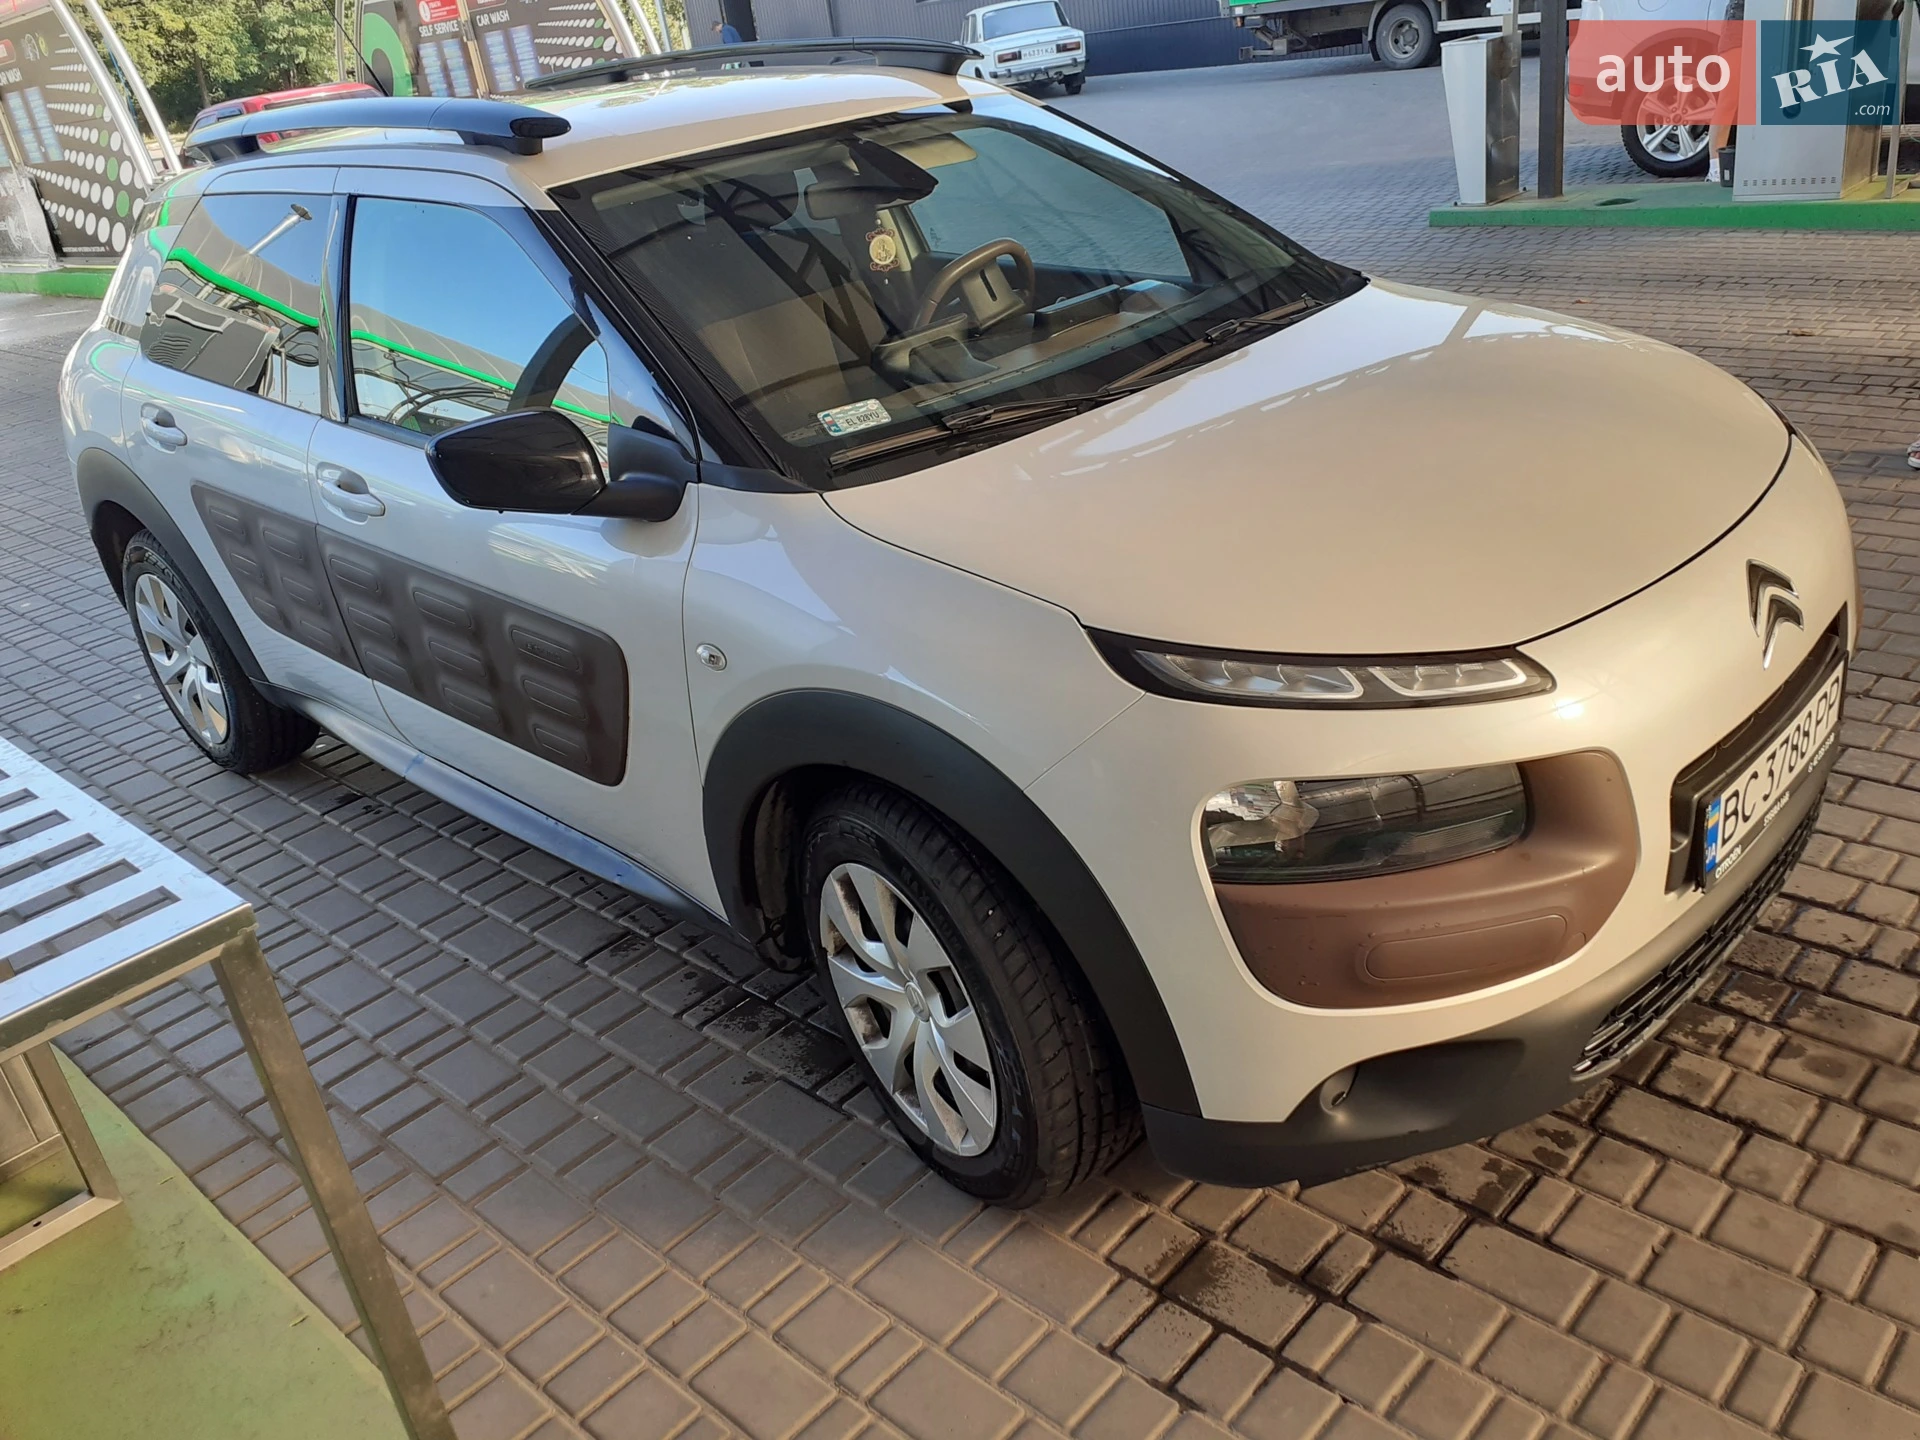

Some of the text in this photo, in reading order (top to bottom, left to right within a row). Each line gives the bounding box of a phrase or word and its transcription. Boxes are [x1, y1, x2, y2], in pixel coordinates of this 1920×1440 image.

[476, 10, 509, 26] CAR WASH
[418, 21, 459, 36] SELF SERVICE
[1721, 769, 1759, 848] BC
[1762, 710, 1812, 802] 3788
[1812, 675, 1840, 744] PP
